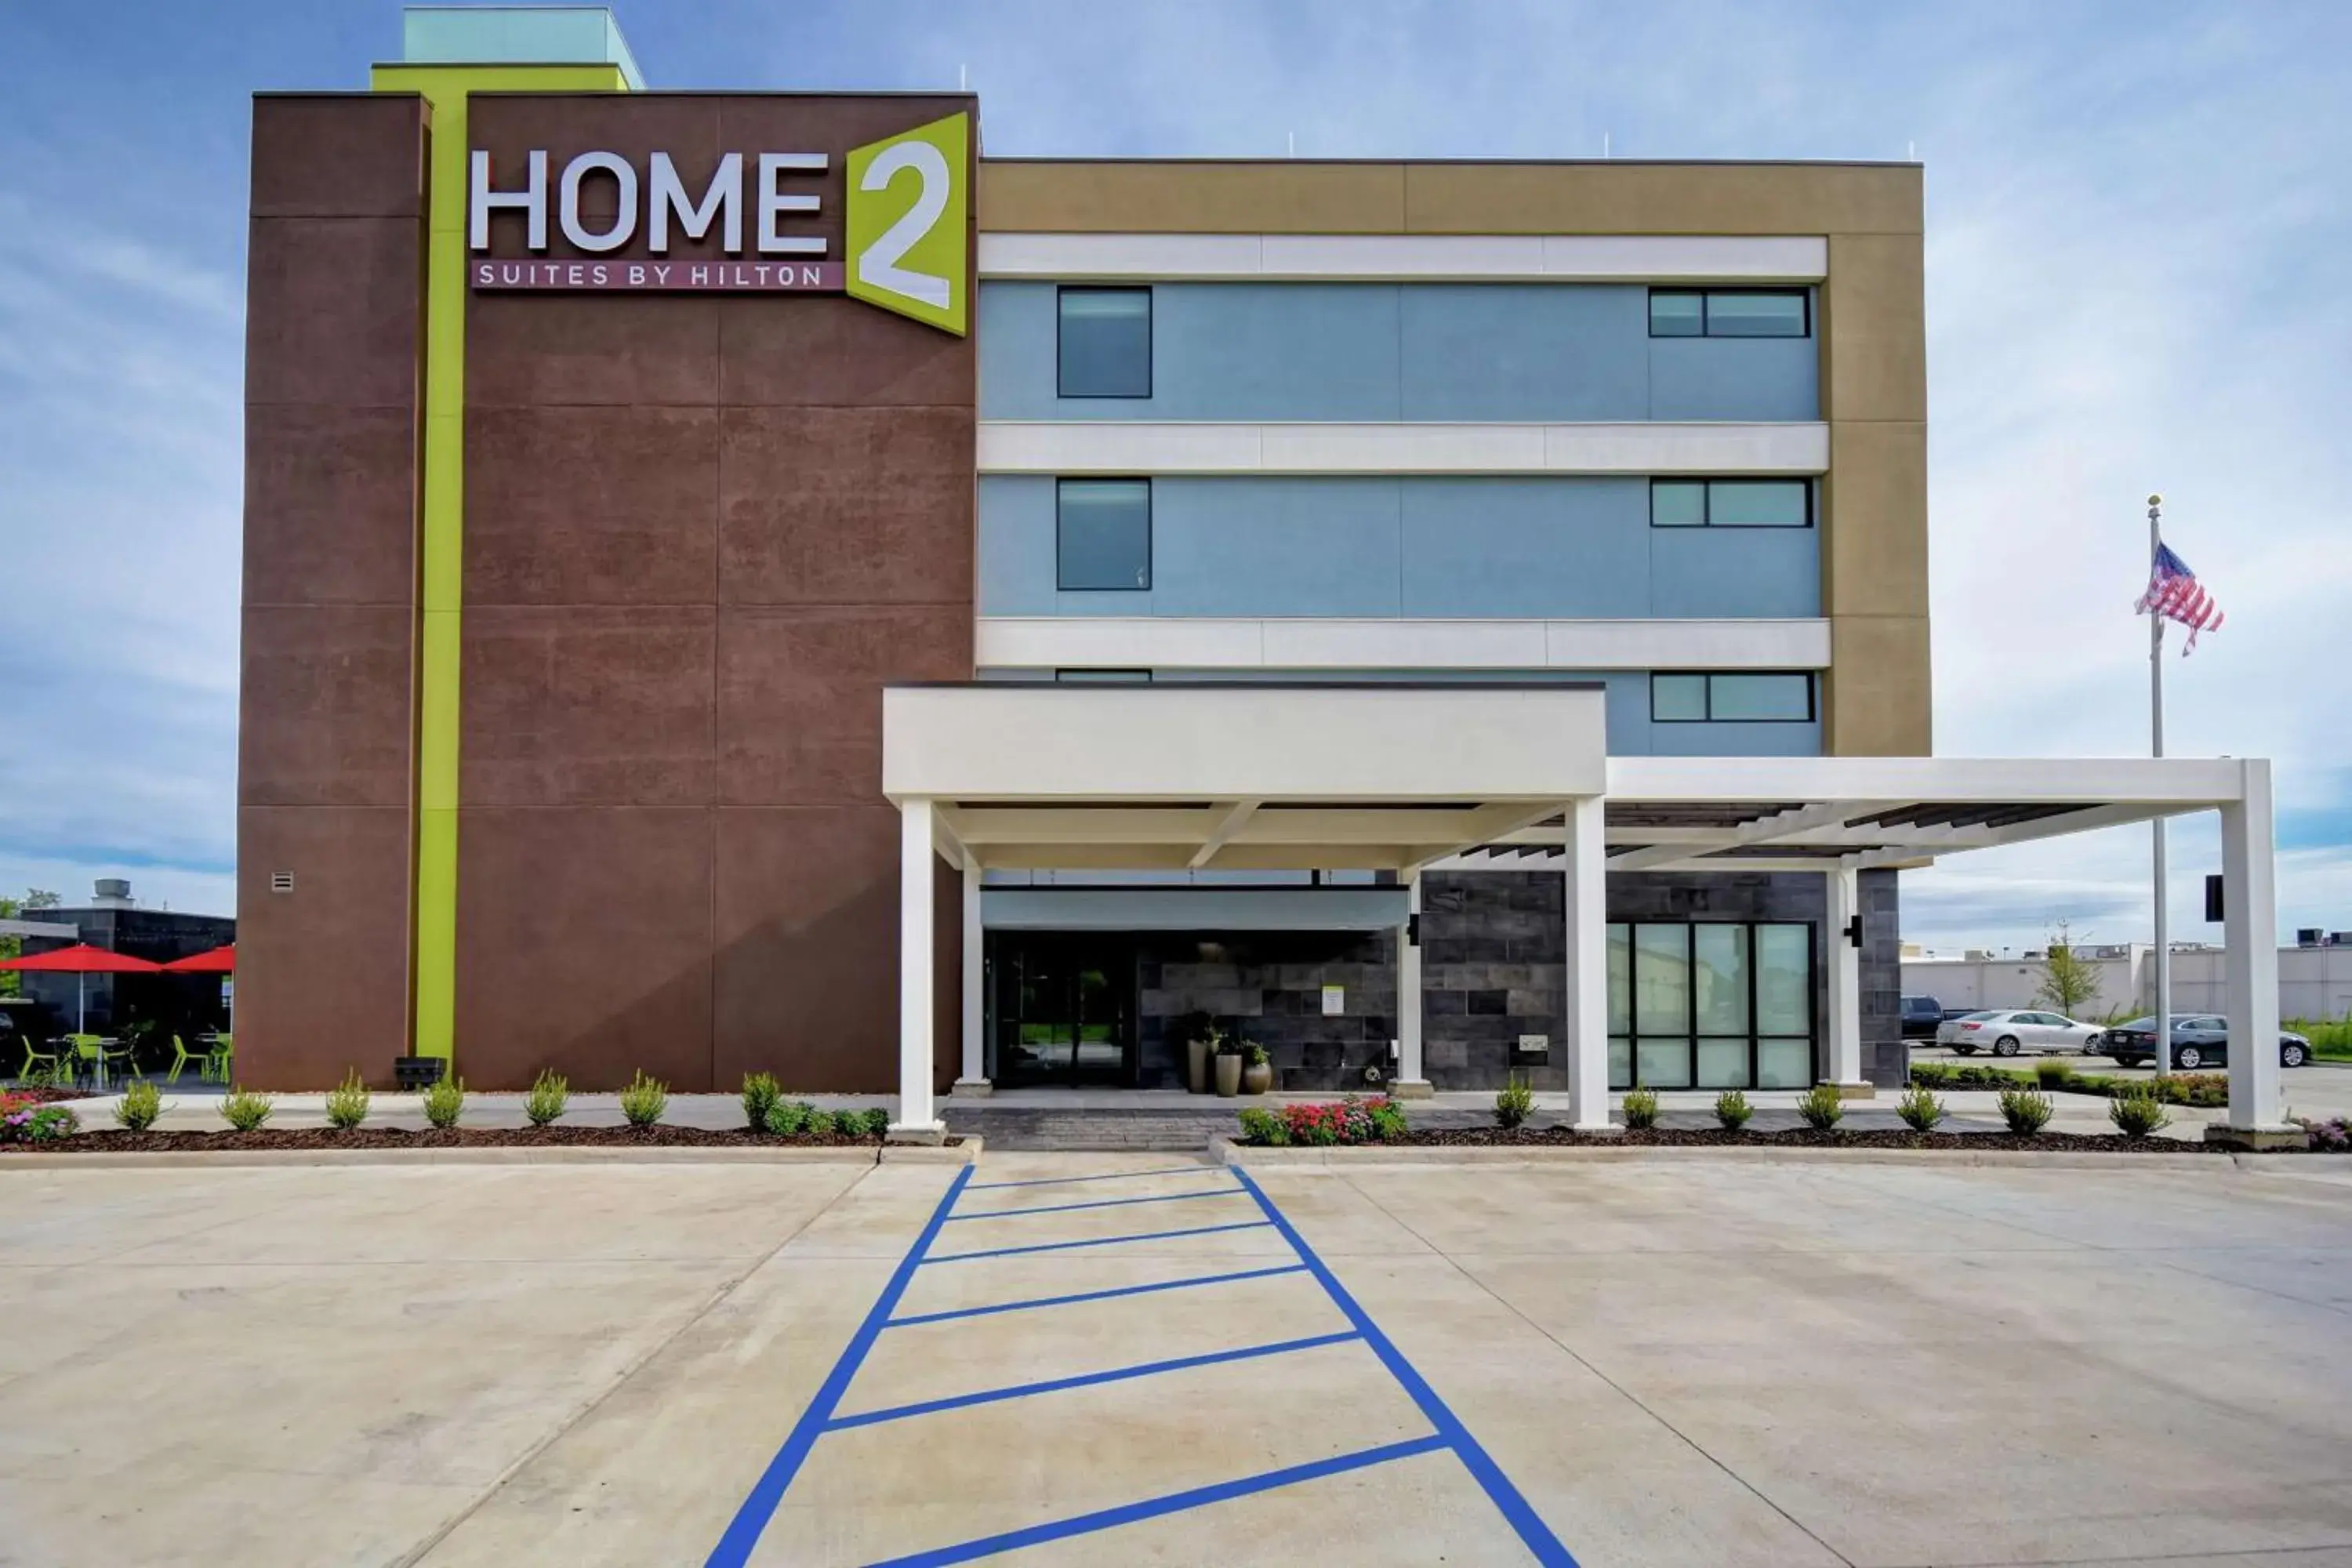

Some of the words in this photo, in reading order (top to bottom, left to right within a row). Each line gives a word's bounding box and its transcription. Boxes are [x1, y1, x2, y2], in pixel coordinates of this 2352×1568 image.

[470, 149, 829, 253] HOME
[858, 140, 950, 310] 2
[479, 264, 608, 285] SUITES
[629, 265, 671, 285] BY
[691, 266, 820, 286] HILTON
